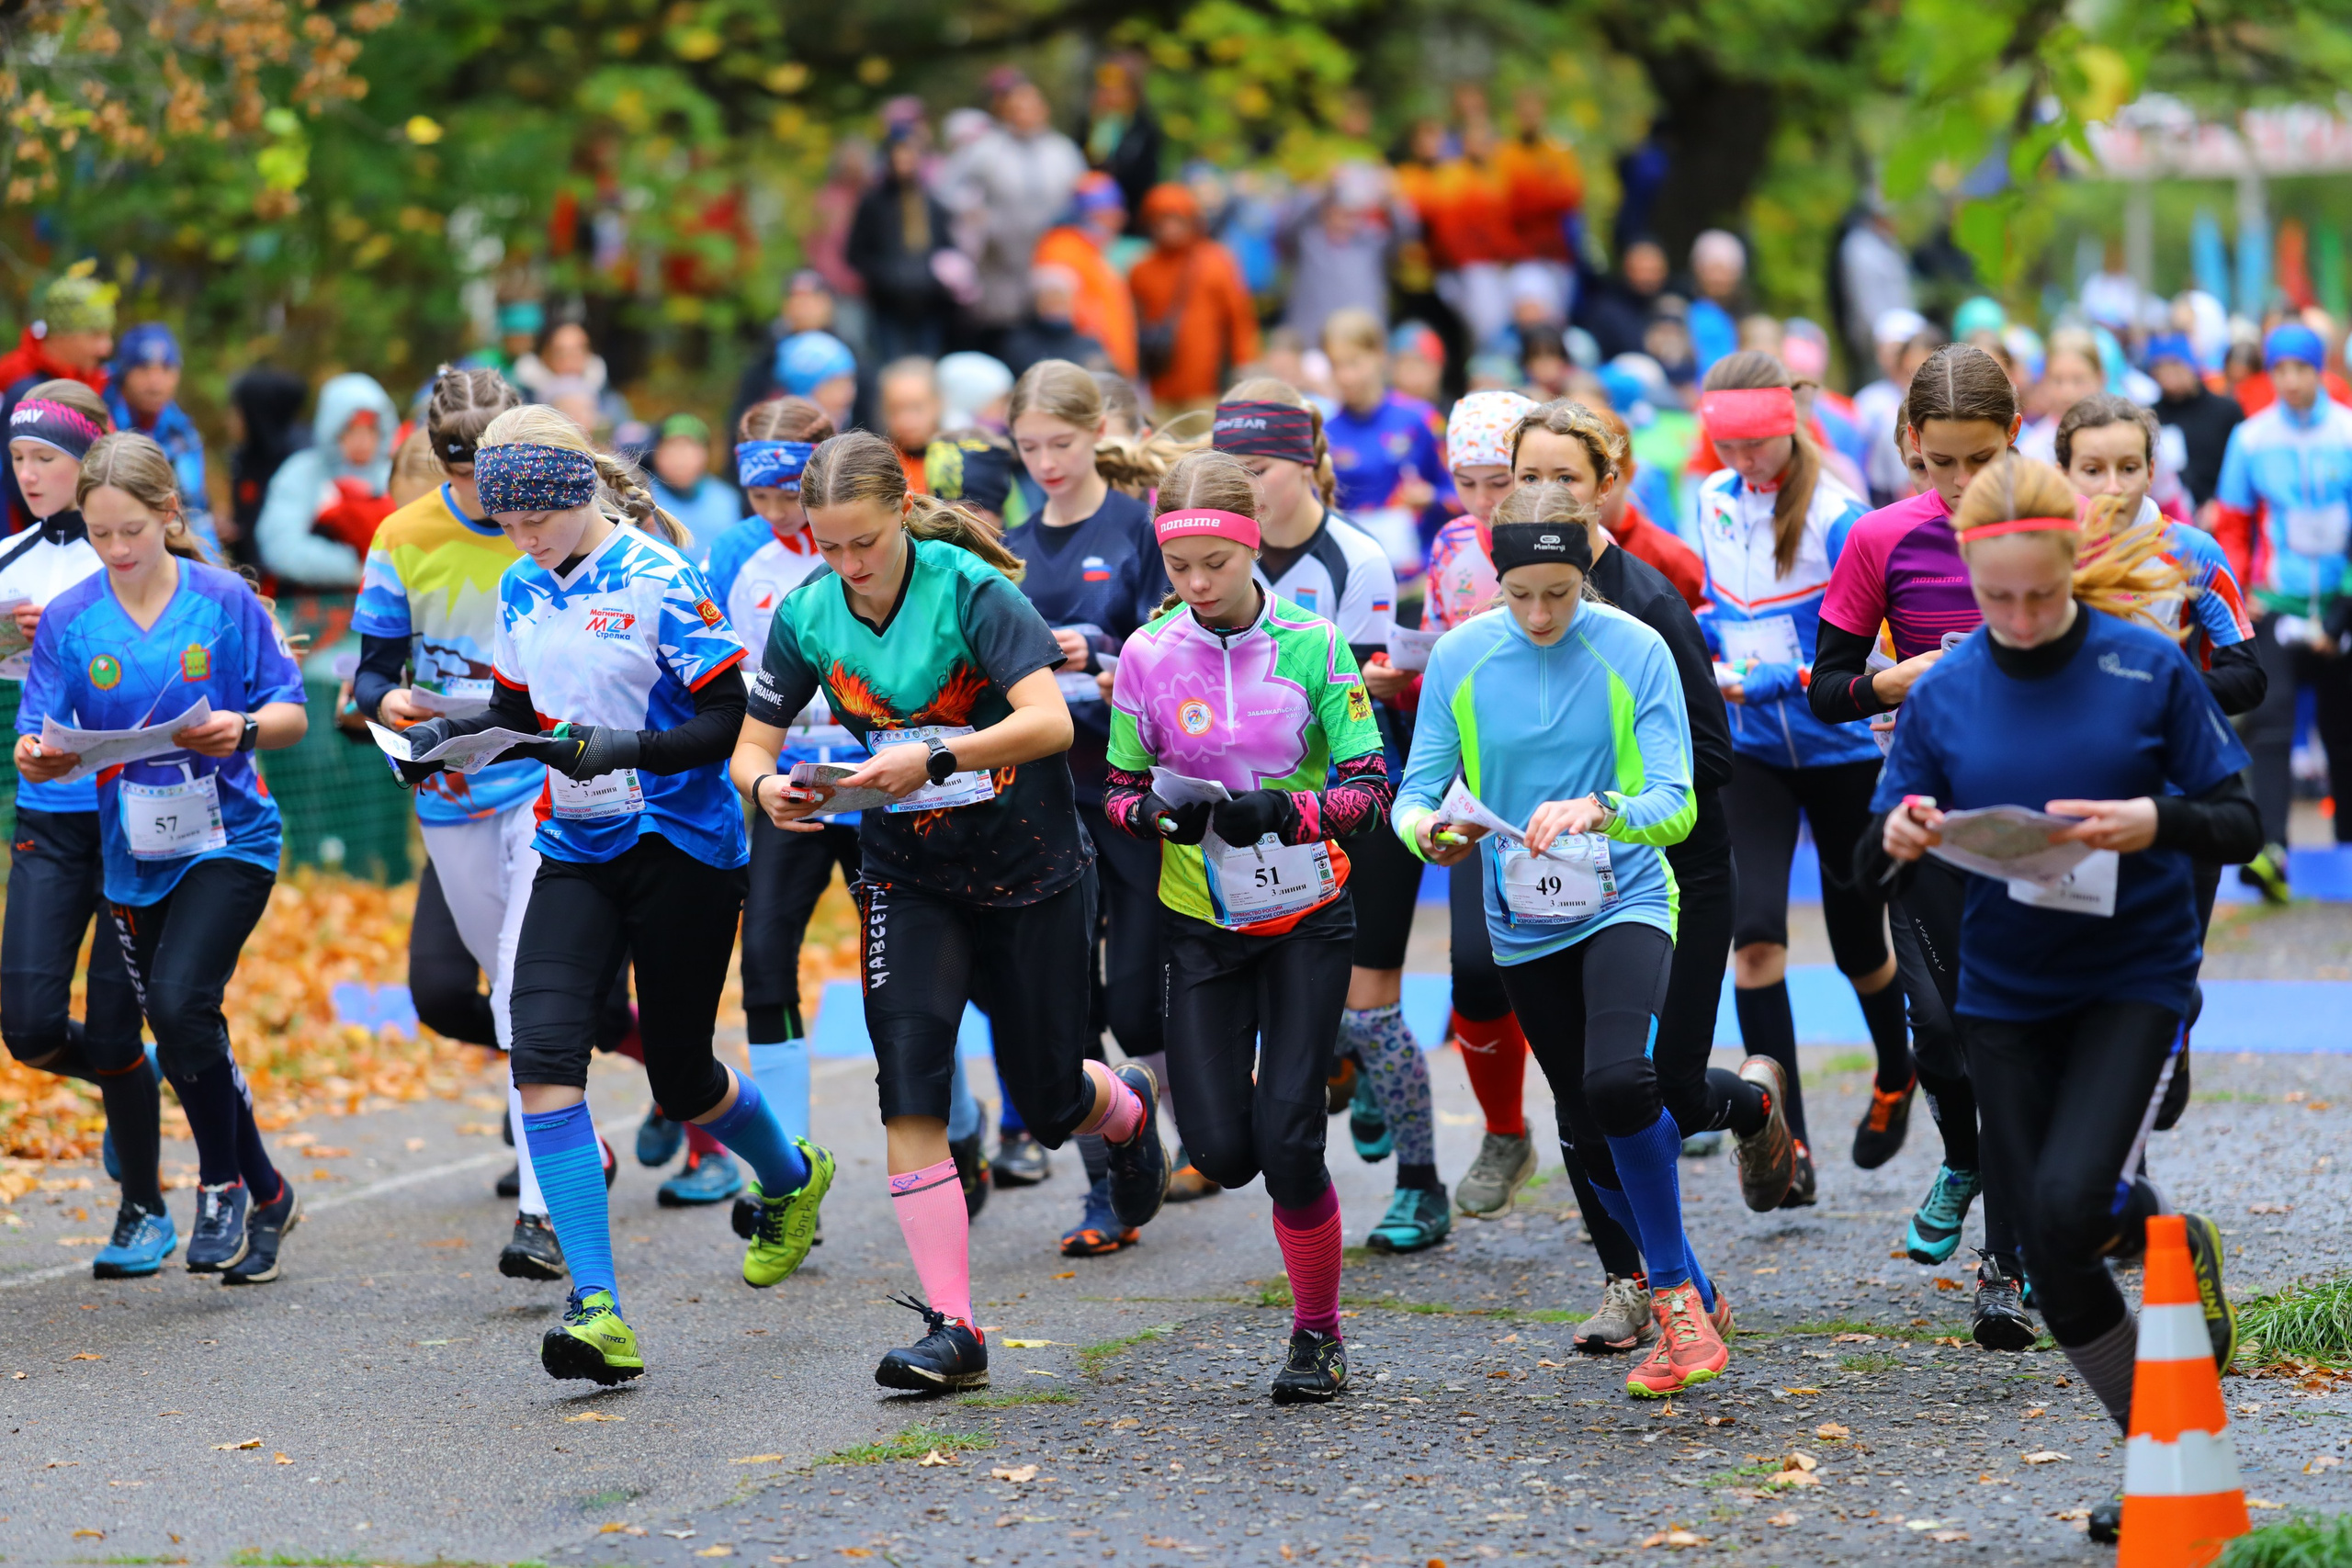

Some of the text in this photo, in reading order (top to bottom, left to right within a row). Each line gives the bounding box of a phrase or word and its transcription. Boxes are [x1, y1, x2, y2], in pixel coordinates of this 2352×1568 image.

[1160, 517, 1221, 534] noname
[1533, 543, 1566, 552] Kalenji
[1911, 576, 1963, 584] noname
[590, 609, 635, 620] Магнитная
[596, 630, 631, 640] Стрелка
[1247, 705, 1303, 716] ЗАБАЙКАЛЬСКИЙ
[584, 790, 589, 798] 3
[591, 786, 617, 796] линия
[934, 797, 970, 808] СОРЕВНОВАНИЯ
[583, 808, 620, 818] СОРЕВНОВАНИЯ
[155, 815, 177, 834] 57
[1255, 866, 1281, 888] 51
[1272, 884, 1306, 897] 3 линия
[1536, 875, 1562, 897] 49
[1550, 899, 1555, 908] 3
[1230, 909, 1262, 918] ПЕРВЕНСТВО
[1273, 903, 1314, 917] СОРЕВНОВАНИЯ
